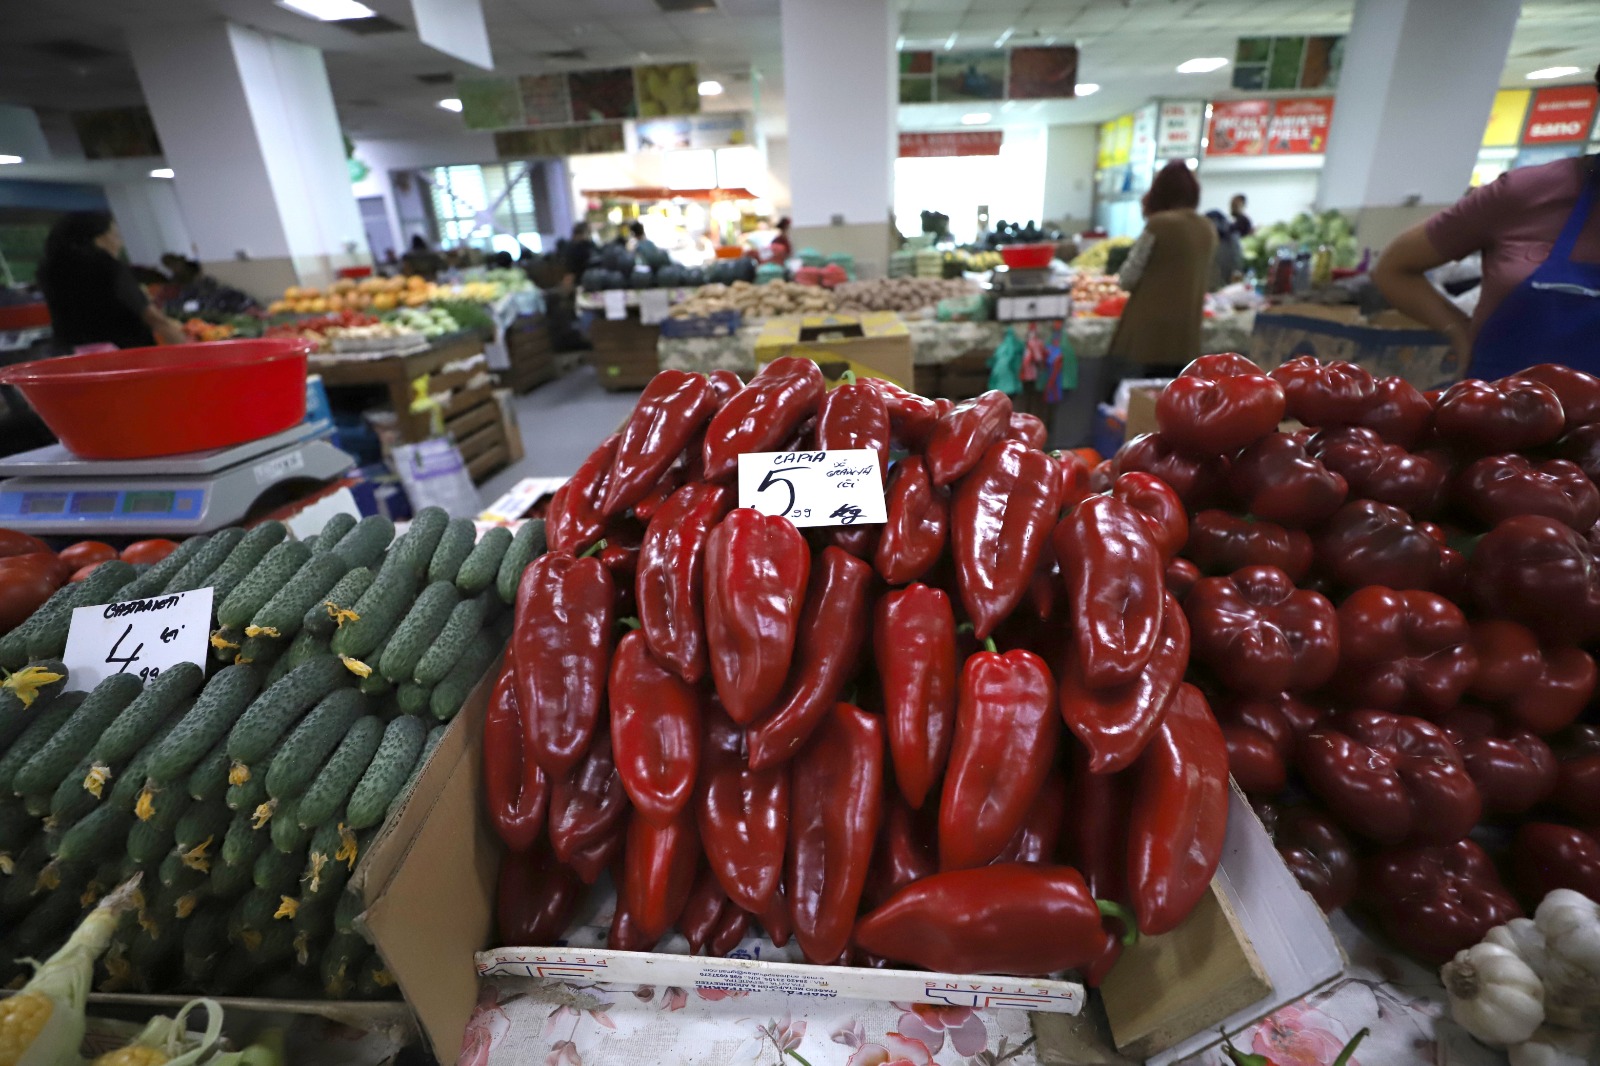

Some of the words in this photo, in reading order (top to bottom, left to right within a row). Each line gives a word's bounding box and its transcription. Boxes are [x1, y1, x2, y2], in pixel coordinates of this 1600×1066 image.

[1530, 121, 1582, 138] sano
[773, 451, 827, 465] CAPIA
[105, 623, 144, 674] 4
[476, 956, 607, 971] PETRANS
[924, 981, 1073, 998] PETRANS
